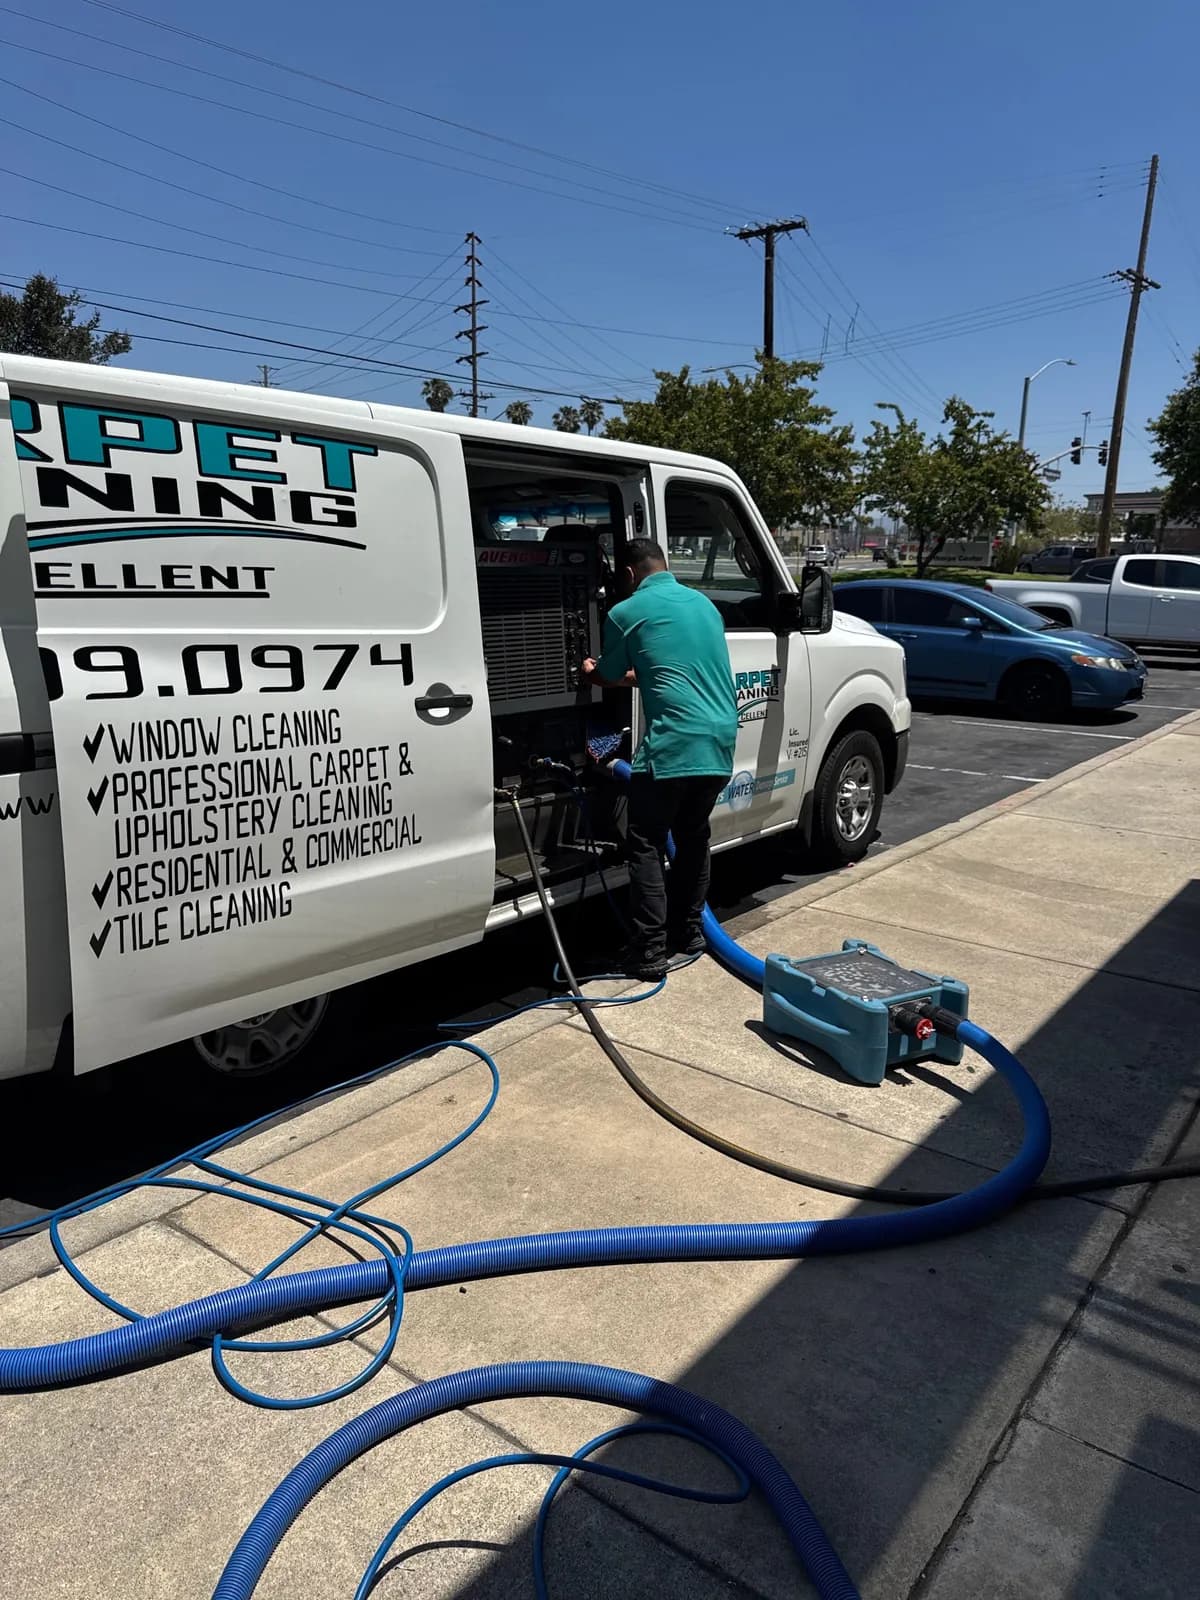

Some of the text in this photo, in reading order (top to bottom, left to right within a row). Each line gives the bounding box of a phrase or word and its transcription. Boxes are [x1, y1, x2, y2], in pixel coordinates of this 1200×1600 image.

[36, 466, 357, 528] NING
[35, 562, 275, 590] ELLENT
[107, 708, 342, 764] WINDOW CLEANING
[112, 742, 414, 814] PROFESSIONAL CARPET &
[115, 783, 393, 859] UPHOLSTERY CLEANING
[117, 815, 422, 907] RESIDENTIAL & COMMERCIAL
[114, 882, 292, 954] TILE CLEANING
